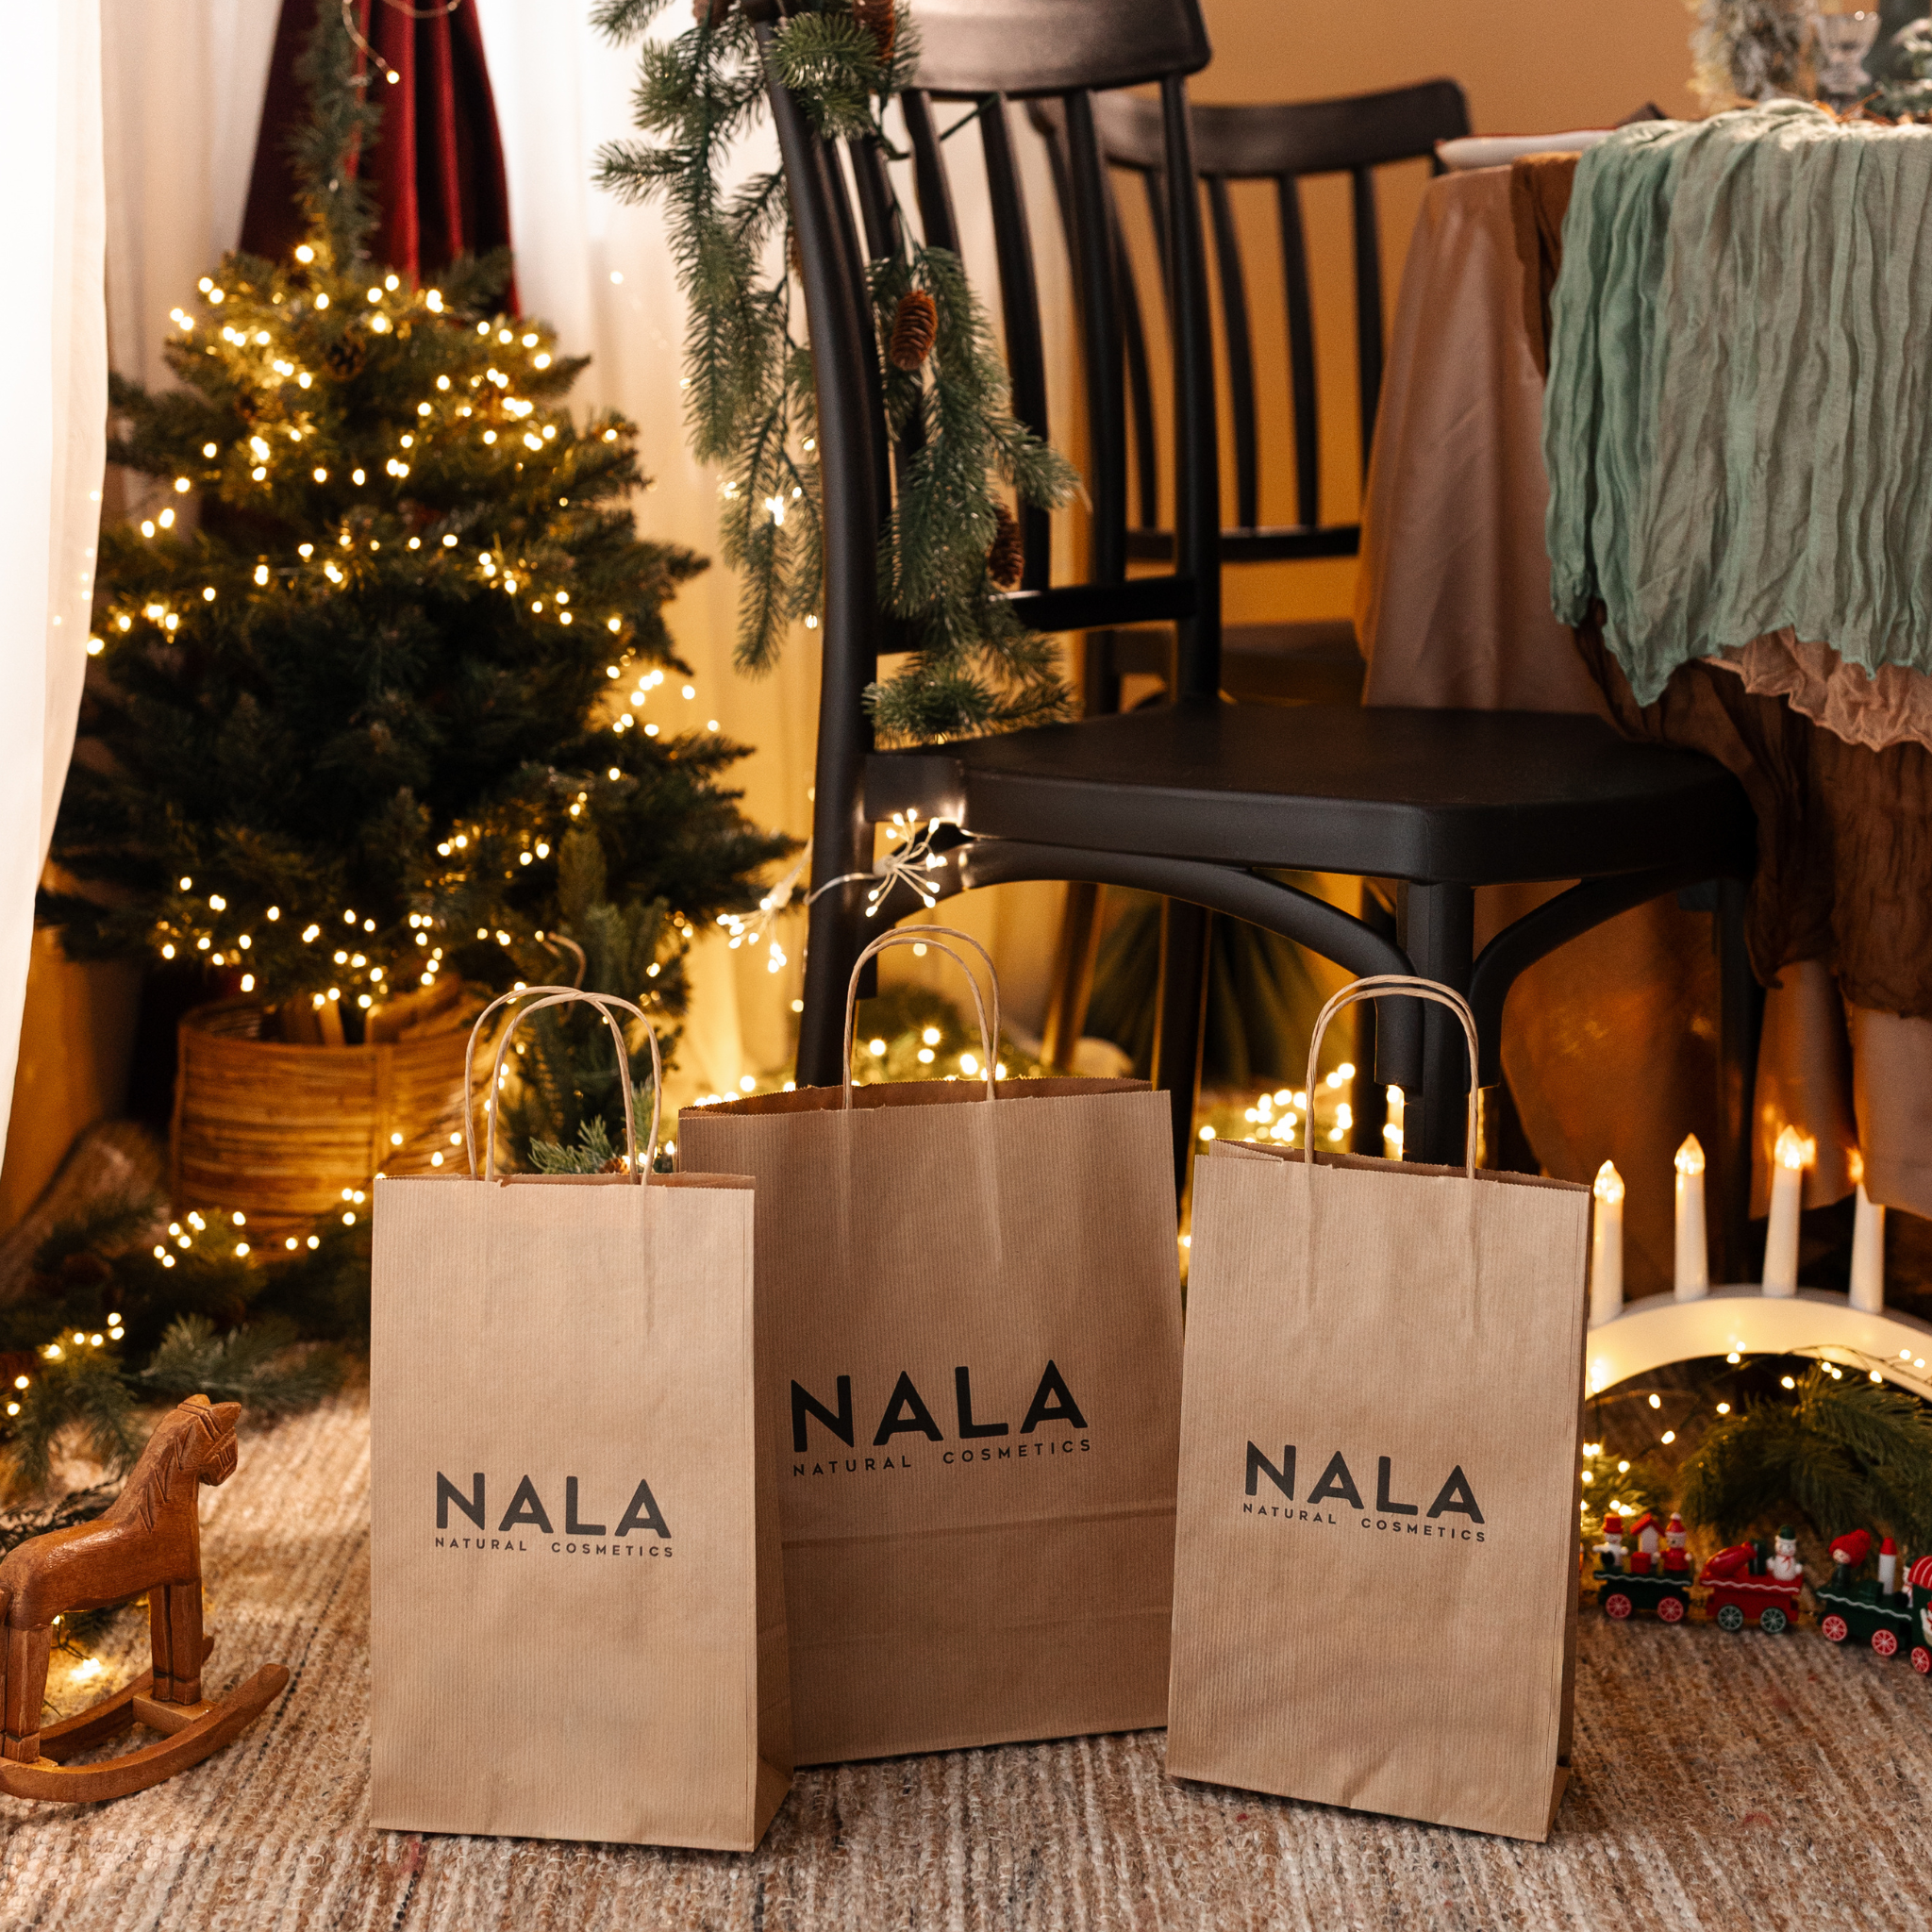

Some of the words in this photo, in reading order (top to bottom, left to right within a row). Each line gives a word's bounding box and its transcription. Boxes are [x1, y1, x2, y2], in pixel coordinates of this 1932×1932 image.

[791, 1358, 1089, 1453] NALA
[793, 1455, 912, 1477] NATURAL
[942, 1439, 1091, 1464] COSMETICS
[1245, 1440, 1486, 1524] NALA
[436, 1471, 672, 1539] NALA
[1243, 1503, 1337, 1524] NATURAL
[1361, 1517, 1486, 1542] COSMETICS
[435, 1537, 527, 1551] NATURAL
[551, 1542, 673, 1557] COSMETICS
